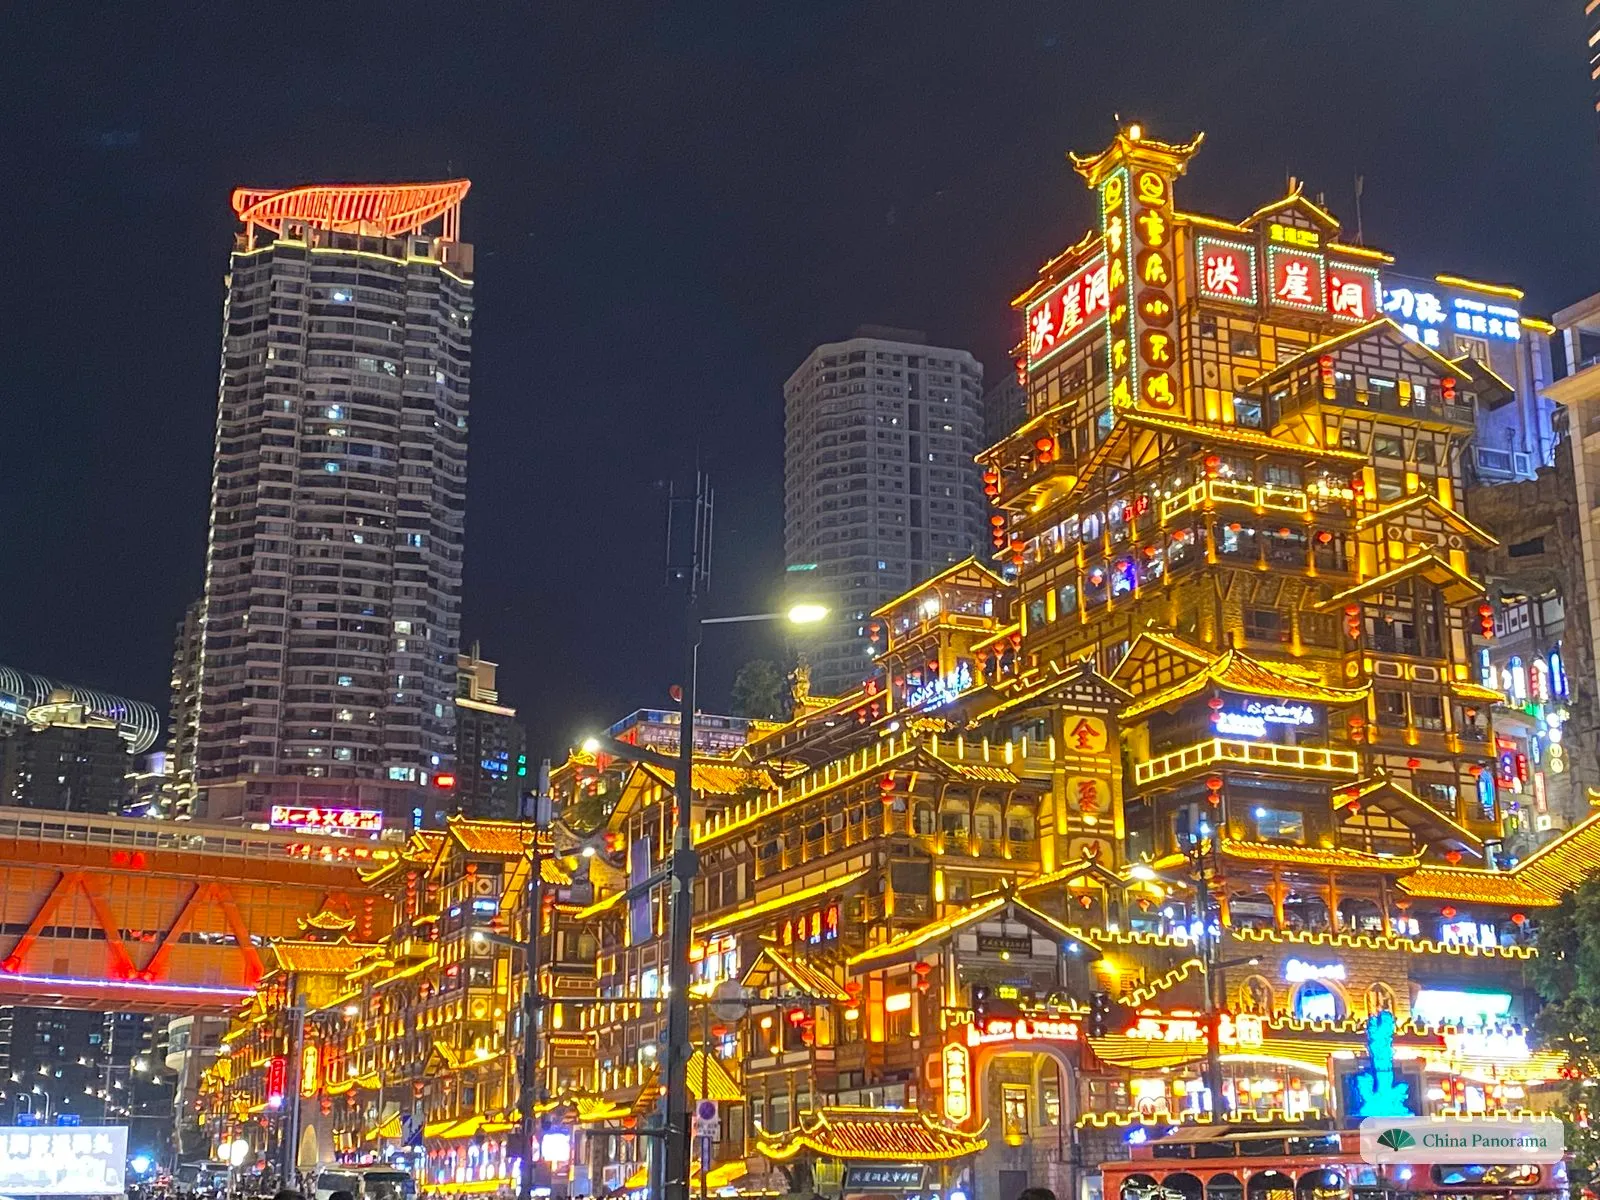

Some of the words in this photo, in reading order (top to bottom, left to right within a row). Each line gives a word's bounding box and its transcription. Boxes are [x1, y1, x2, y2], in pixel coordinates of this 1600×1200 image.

[1030, 265, 1110, 356] 洪崖洞
[1206, 255, 1364, 318] 洪崖洞
